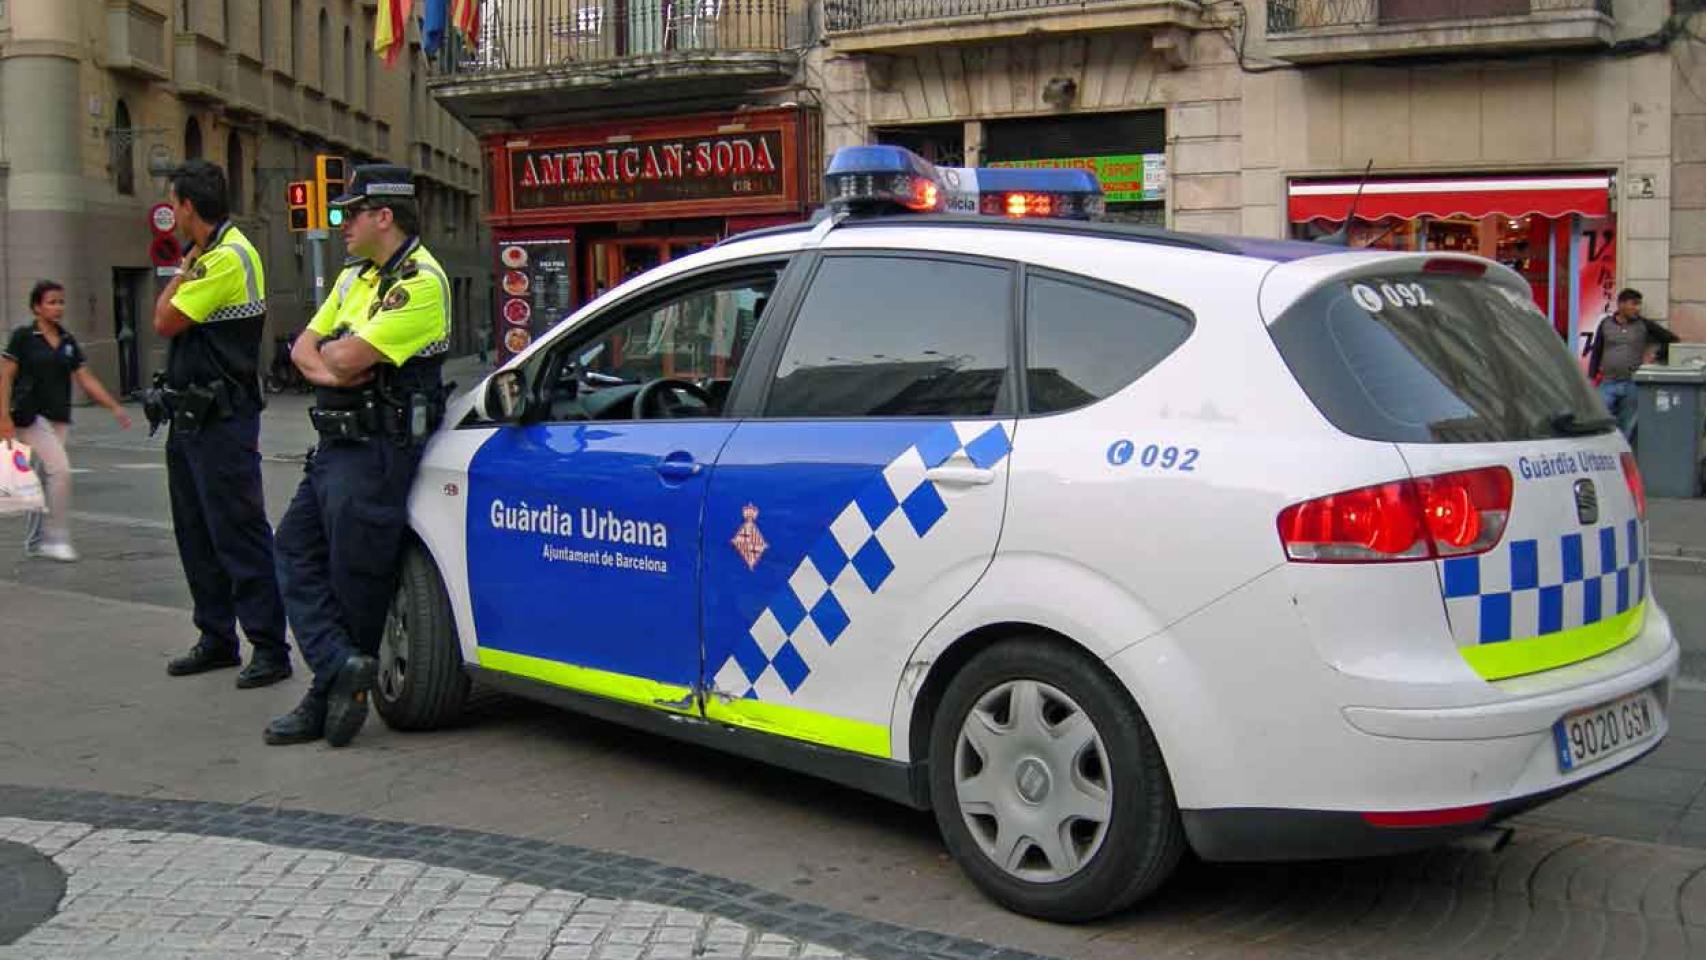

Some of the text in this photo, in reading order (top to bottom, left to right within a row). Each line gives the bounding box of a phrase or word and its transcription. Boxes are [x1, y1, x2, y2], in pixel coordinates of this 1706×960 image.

[1380, 283, 1434, 307] 092
[1141, 444, 1199, 471] 092
[1519, 452, 1577, 479] Guàrdia
[490, 499, 667, 548] Guàrdia Urbana
[543, 544, 667, 573] Ajuntament de Barcelona
[1571, 711, 1619, 759] 9020
